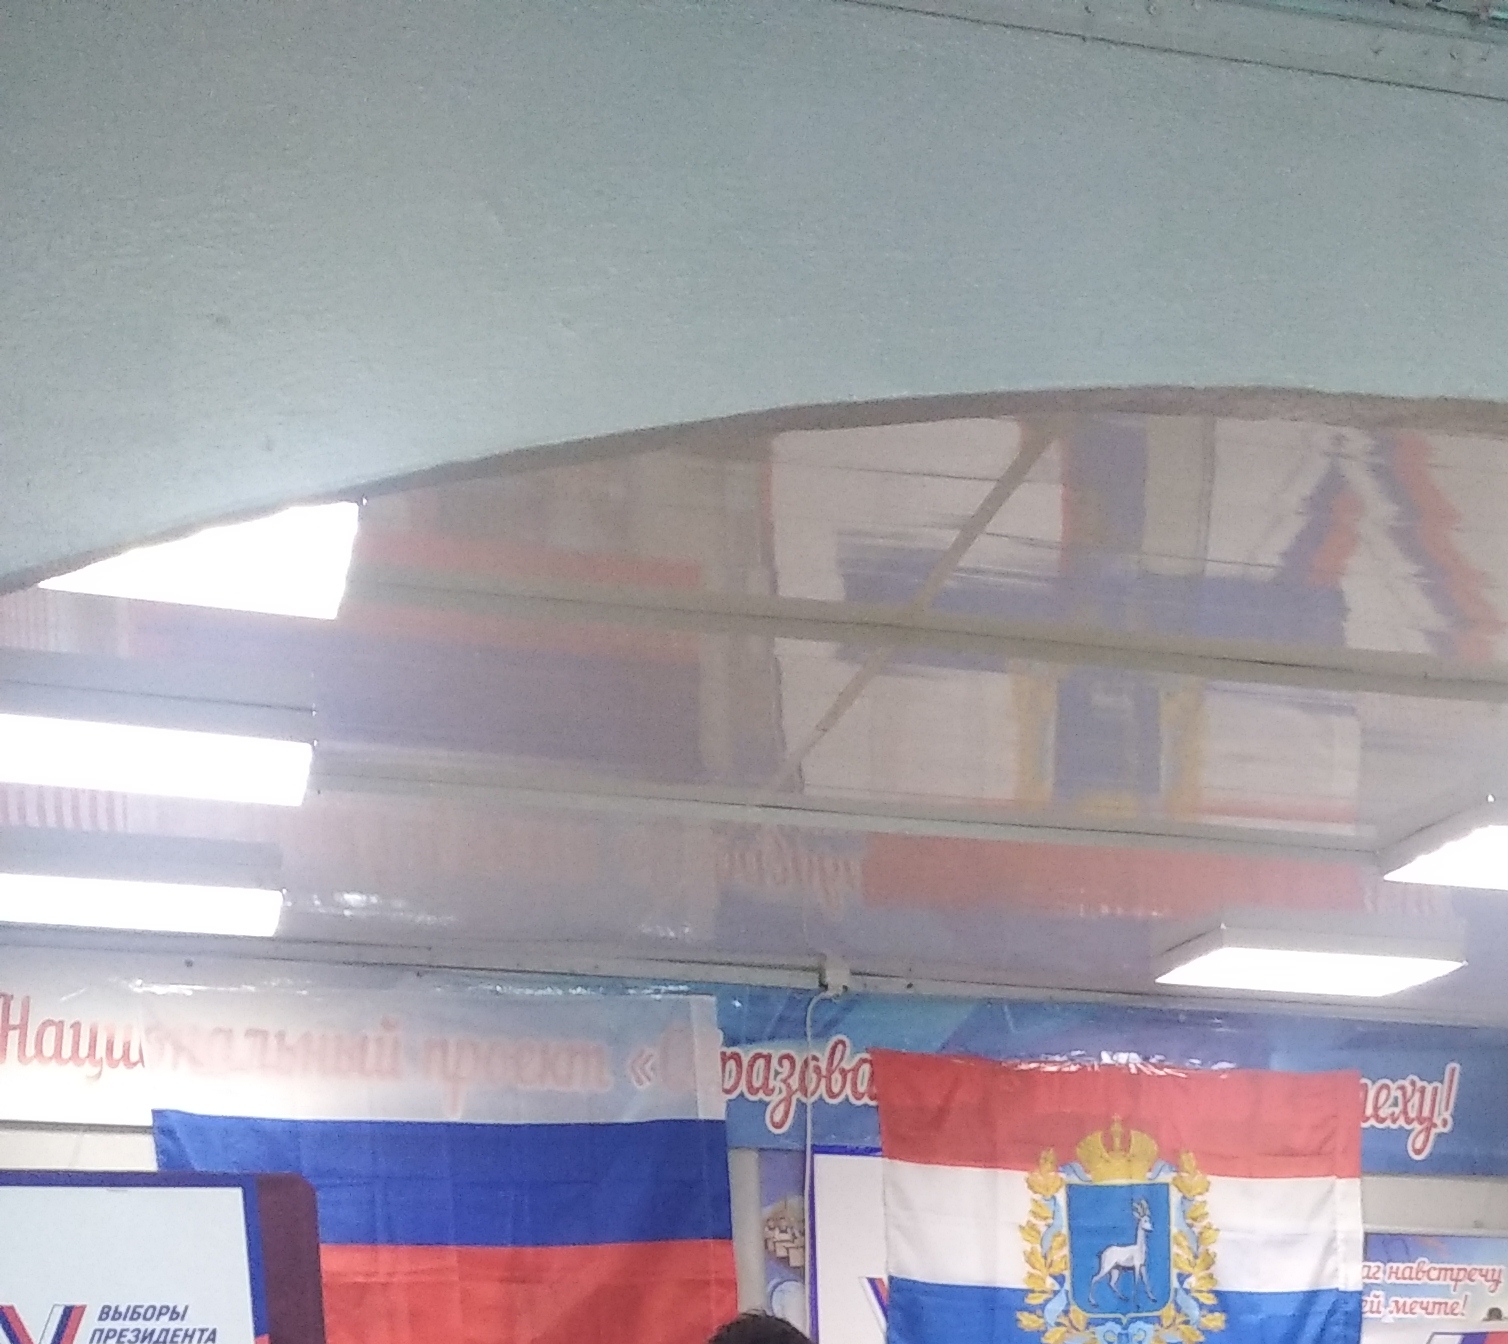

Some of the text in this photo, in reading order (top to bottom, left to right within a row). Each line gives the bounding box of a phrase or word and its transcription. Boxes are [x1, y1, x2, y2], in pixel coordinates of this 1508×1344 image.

[1387, 1260, 1504, 1294] навстречу
[97, 1304, 190, 1322] ВЫБОРЫ
[1388, 1294, 1469, 1316] мечте!
